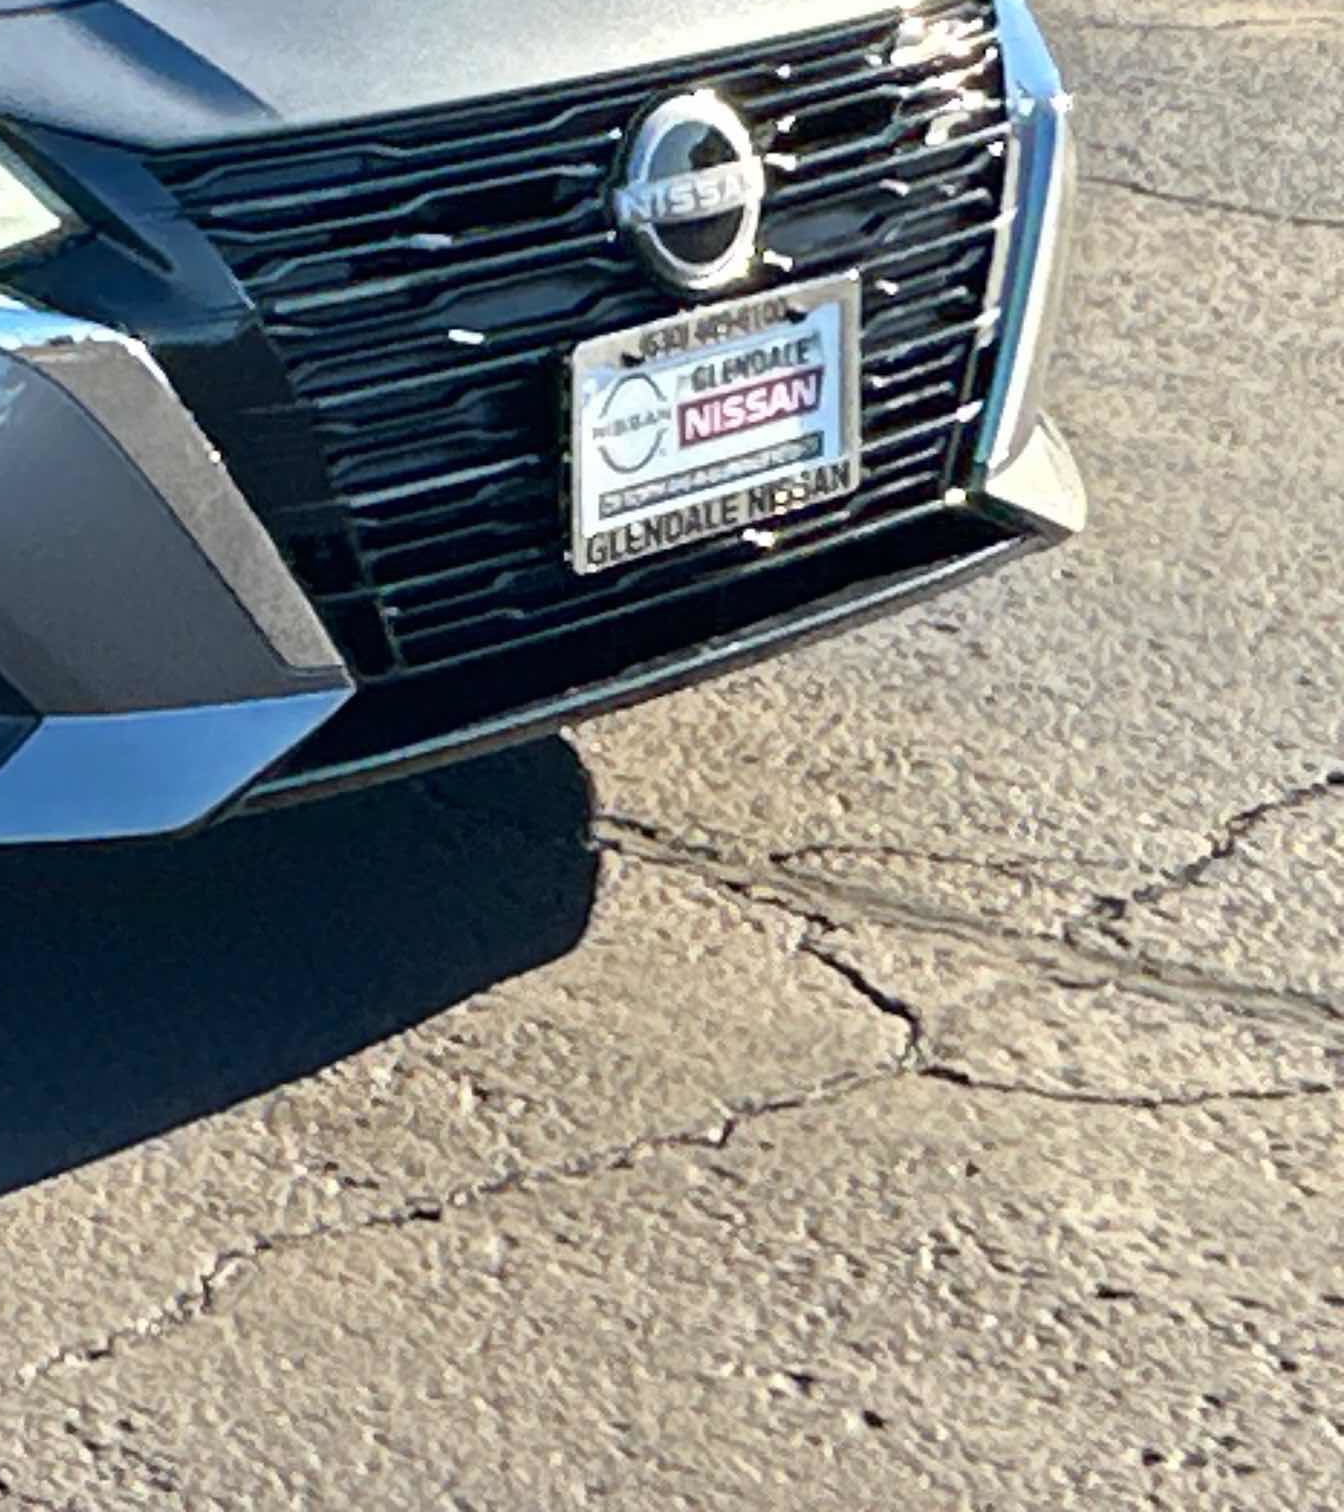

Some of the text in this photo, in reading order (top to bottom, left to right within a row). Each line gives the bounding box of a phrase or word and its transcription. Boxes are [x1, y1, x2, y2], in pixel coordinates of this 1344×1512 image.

[620, 168, 762, 224] NISSA
[691, 337, 809, 392] GLENDALE
[682, 377, 817, 442] NISSAN
[586, 496, 738, 567] GLENDALE
[748, 462, 851, 517] NISSAN
